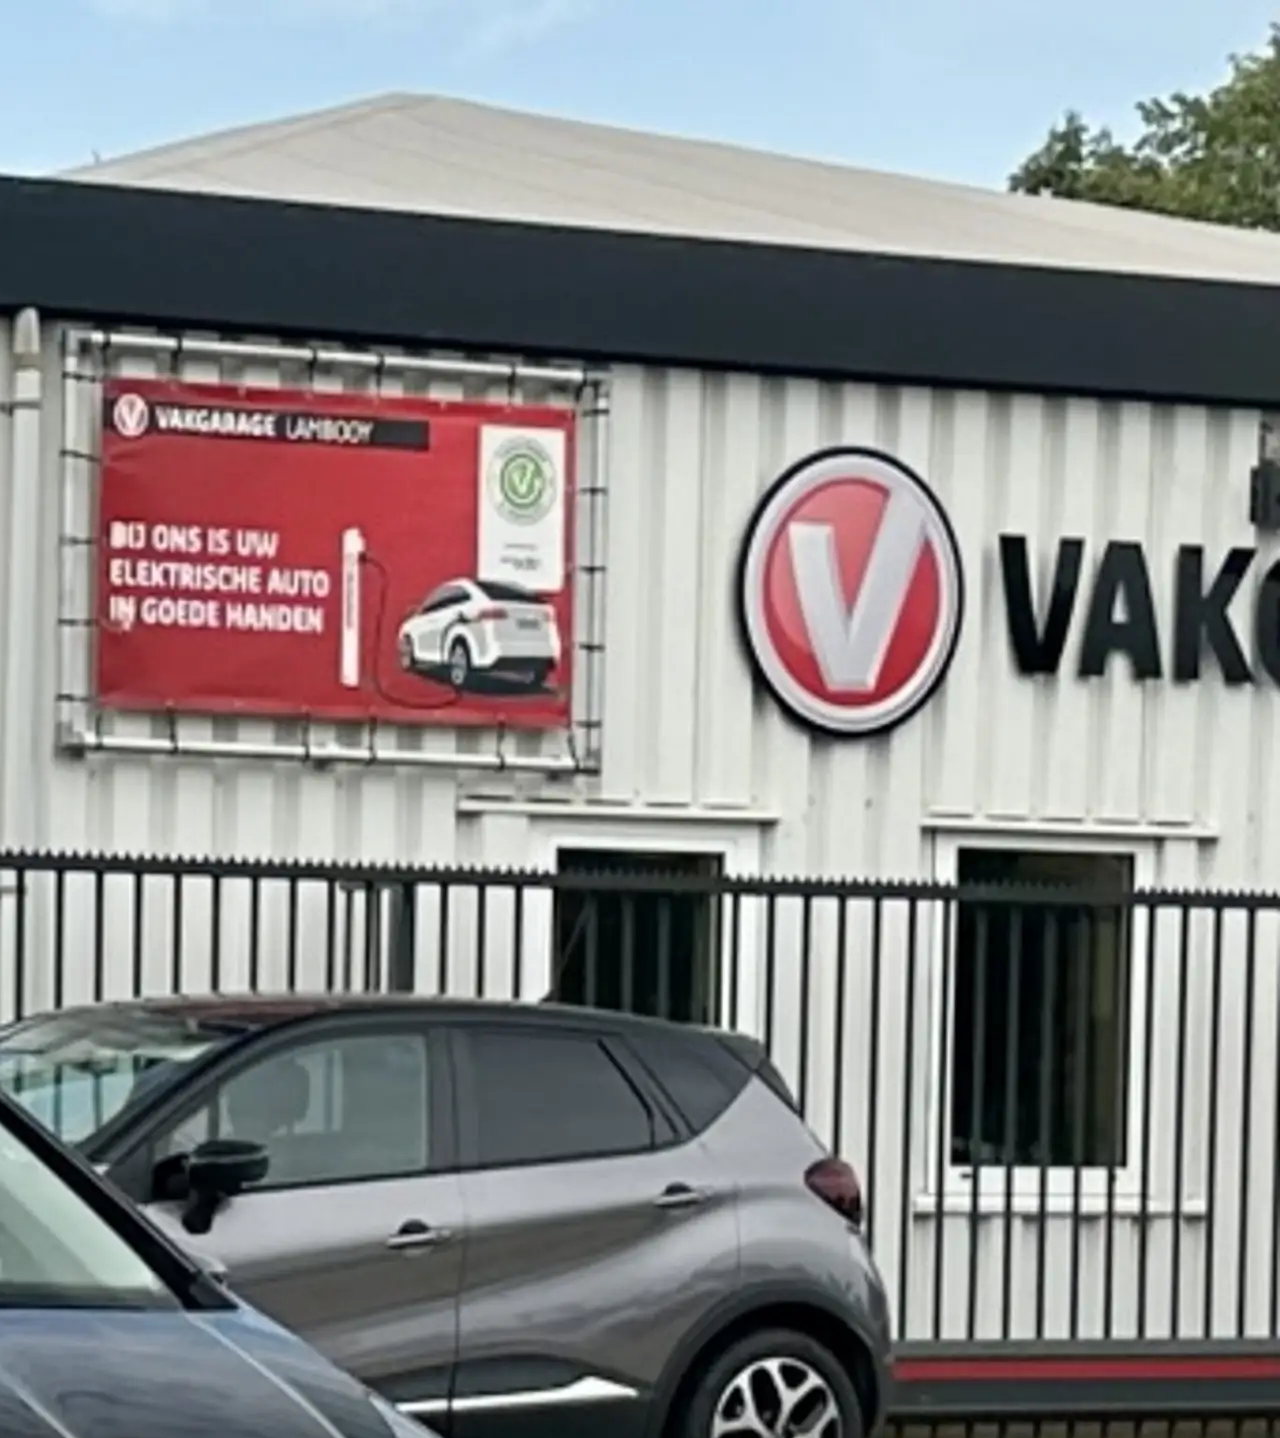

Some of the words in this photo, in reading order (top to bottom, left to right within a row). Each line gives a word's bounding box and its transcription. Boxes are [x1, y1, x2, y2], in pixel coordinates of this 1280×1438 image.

[155, 404, 276, 437] VAKGARAGE
[109, 521, 146, 549] BIJ
[151, 524, 203, 554] ONS
[207, 527, 231, 555] IS
[236, 530, 279, 558] UW
[109, 558, 262, 594] ELEKTRISCHE
[267, 568, 331, 598] AUTO
[109, 594, 137, 623] IN
[141, 596, 220, 628] GOEDE
[225, 601, 325, 635] HANDEN
